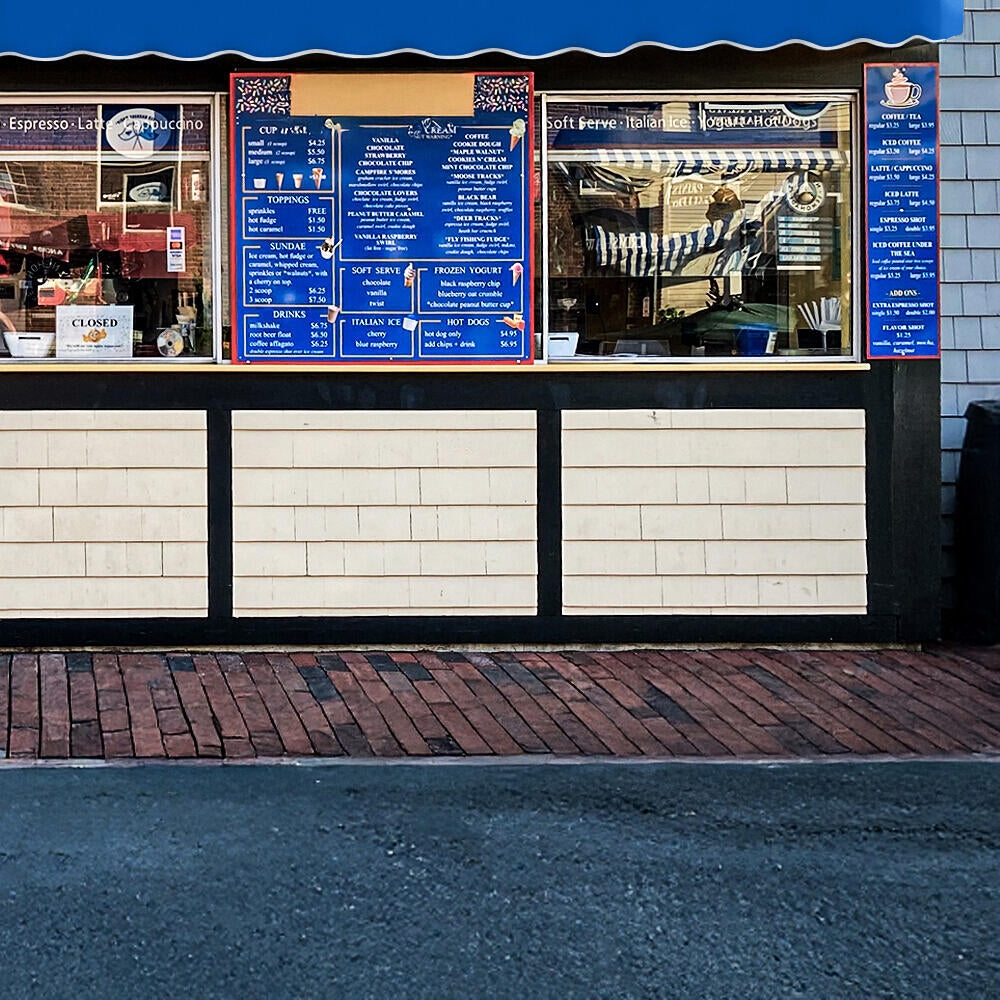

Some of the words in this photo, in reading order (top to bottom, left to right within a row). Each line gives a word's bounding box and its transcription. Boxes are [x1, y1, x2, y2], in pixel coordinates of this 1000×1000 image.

[10, 116, 69, 133] Espresso
[547, 116, 574, 129] Soft
[579, 116, 617, 129] Serve
[626, 116, 665, 129] Italian
[671, 116, 688, 129] Ice
[248, 158, 263, 166] large
[267, 196, 310, 204] TOPPINGS
[458, 280, 486, 288] raspberry
[487, 280, 501, 288] chip
[72, 319, 118, 327] CLOSED
